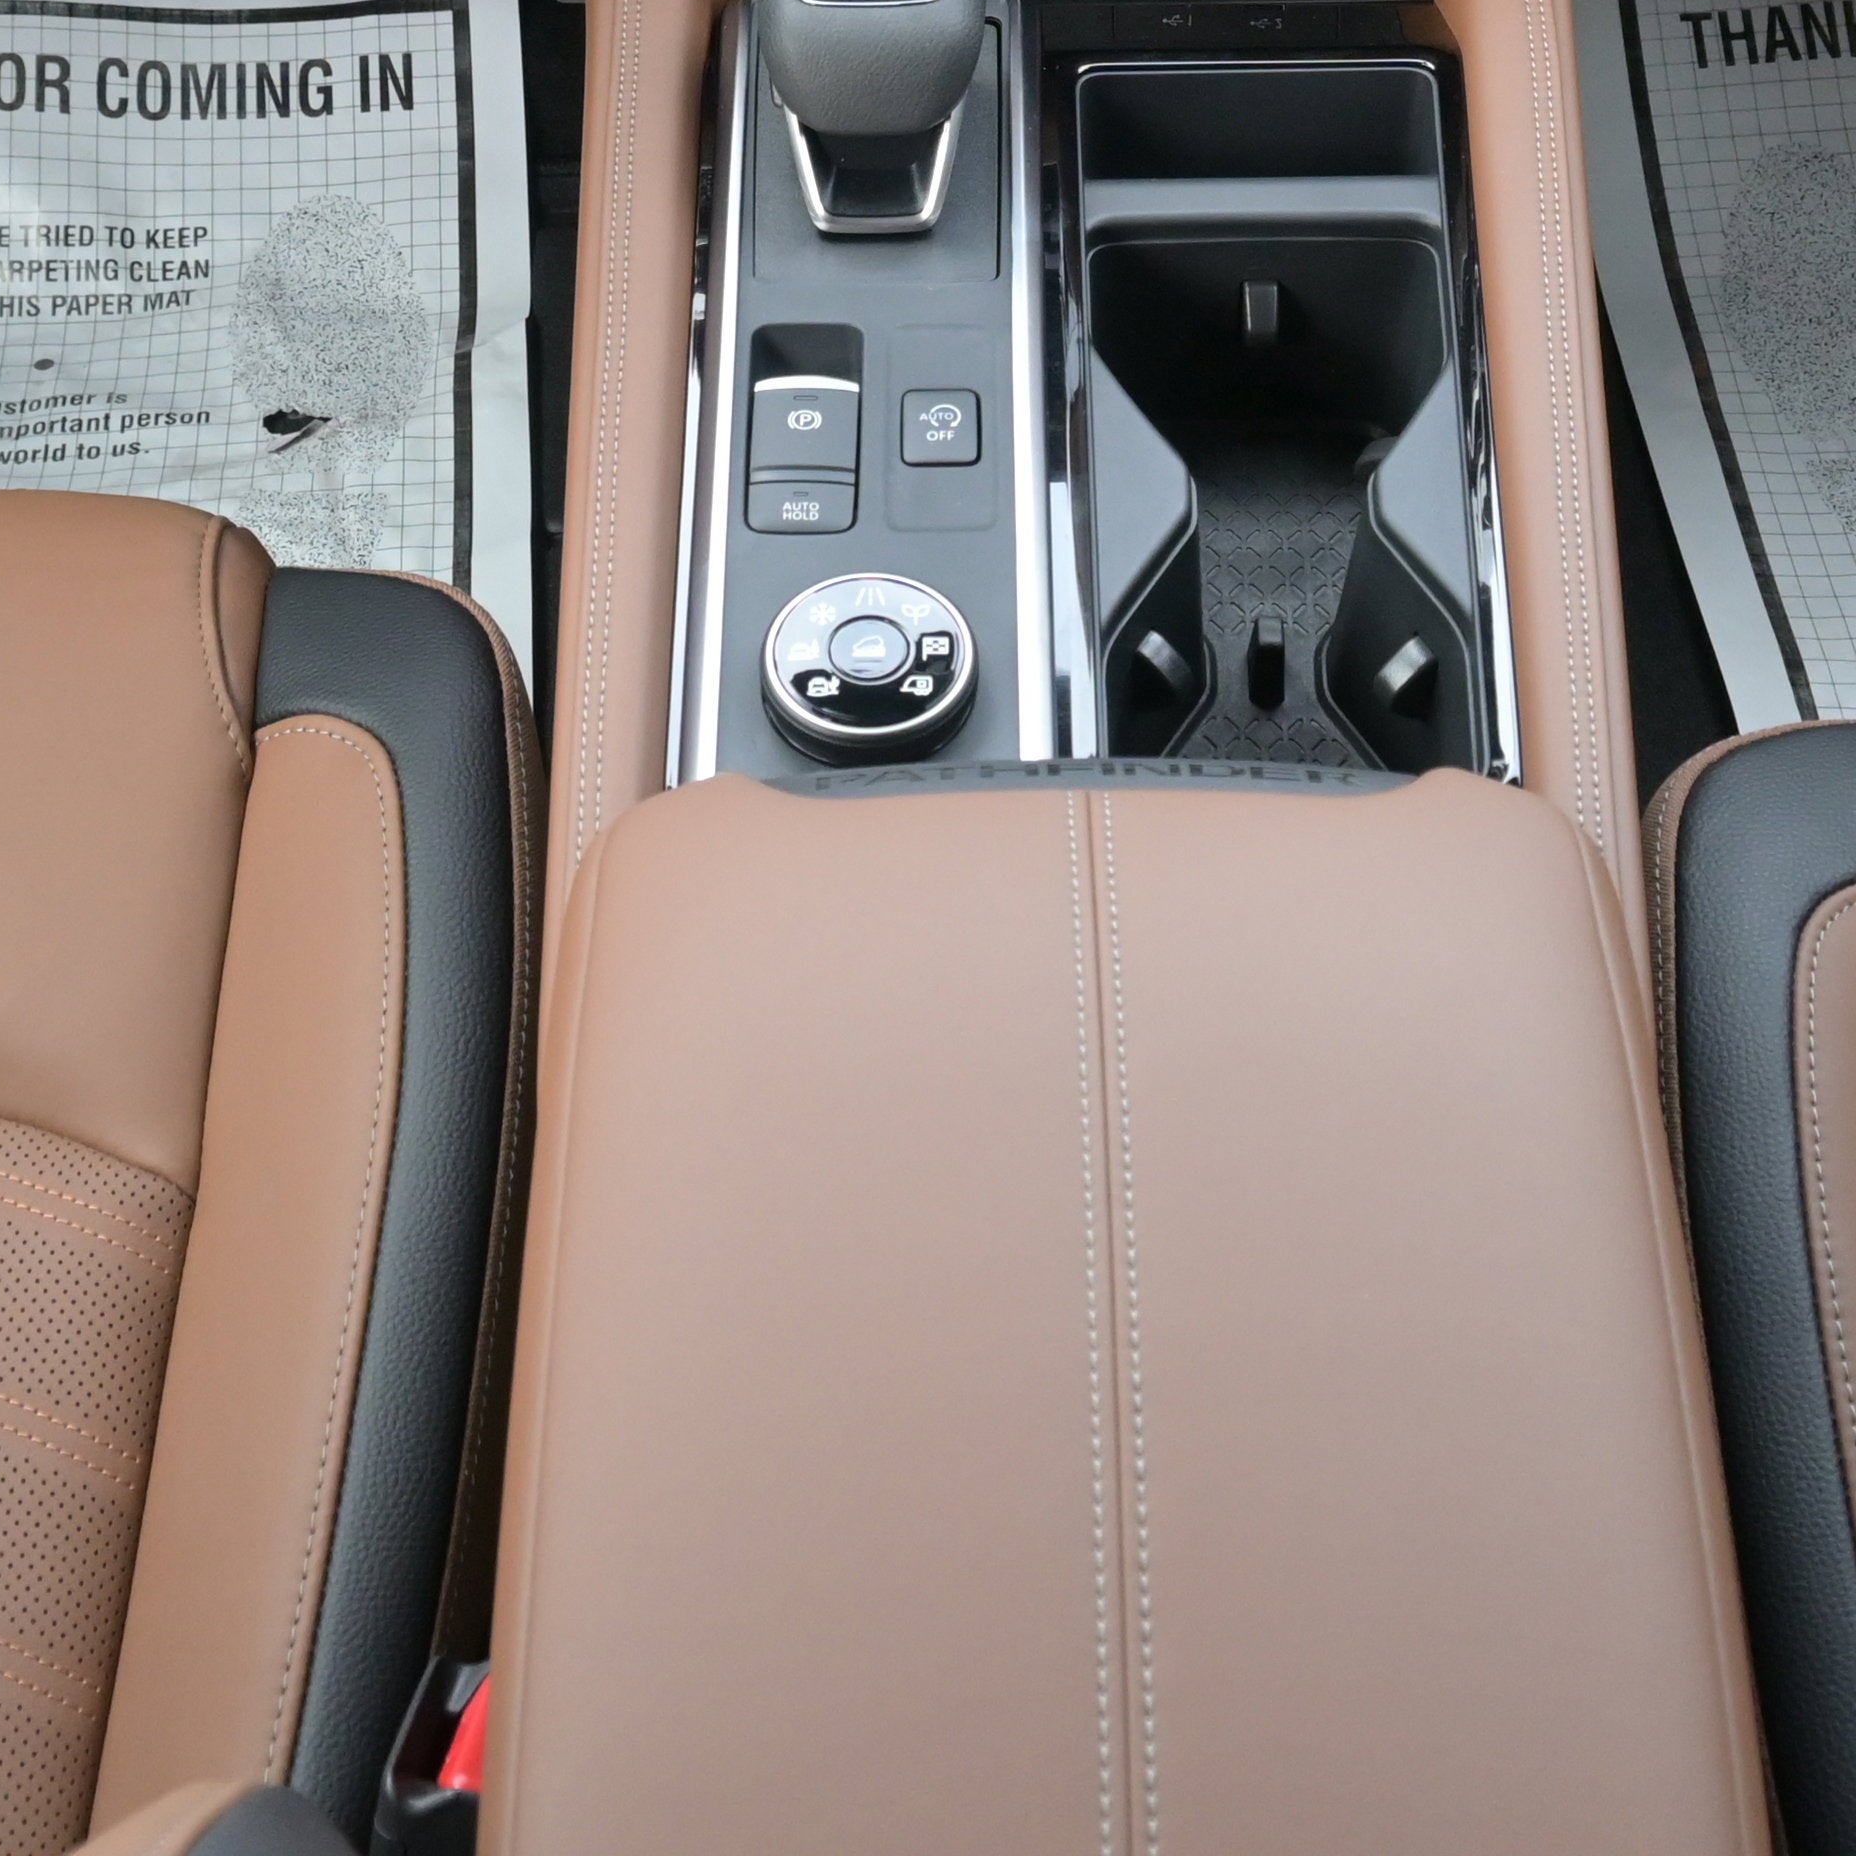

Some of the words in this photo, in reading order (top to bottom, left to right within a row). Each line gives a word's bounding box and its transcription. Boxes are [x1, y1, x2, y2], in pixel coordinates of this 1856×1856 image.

[96, 55, 334, 121] COMING
[358, 53, 415, 113] IN
[19, 224, 95, 248] TRIED
[104, 226, 136, 250] TO
[145, 226, 209, 250] KEEP
[129, 259, 211, 283] CLEAN
[51, 293, 133, 317] PAPER
[144, 289, 196, 312] MAT
[106, 392, 128, 405] is
[120, 409, 211, 430] person
[926, 431, 955, 441] OFF
[77, 443, 101, 461] to
[111, 441, 149, 456] us.
[782, 502, 820, 511] AUTO
[782, 511, 819, 520] HOLD
